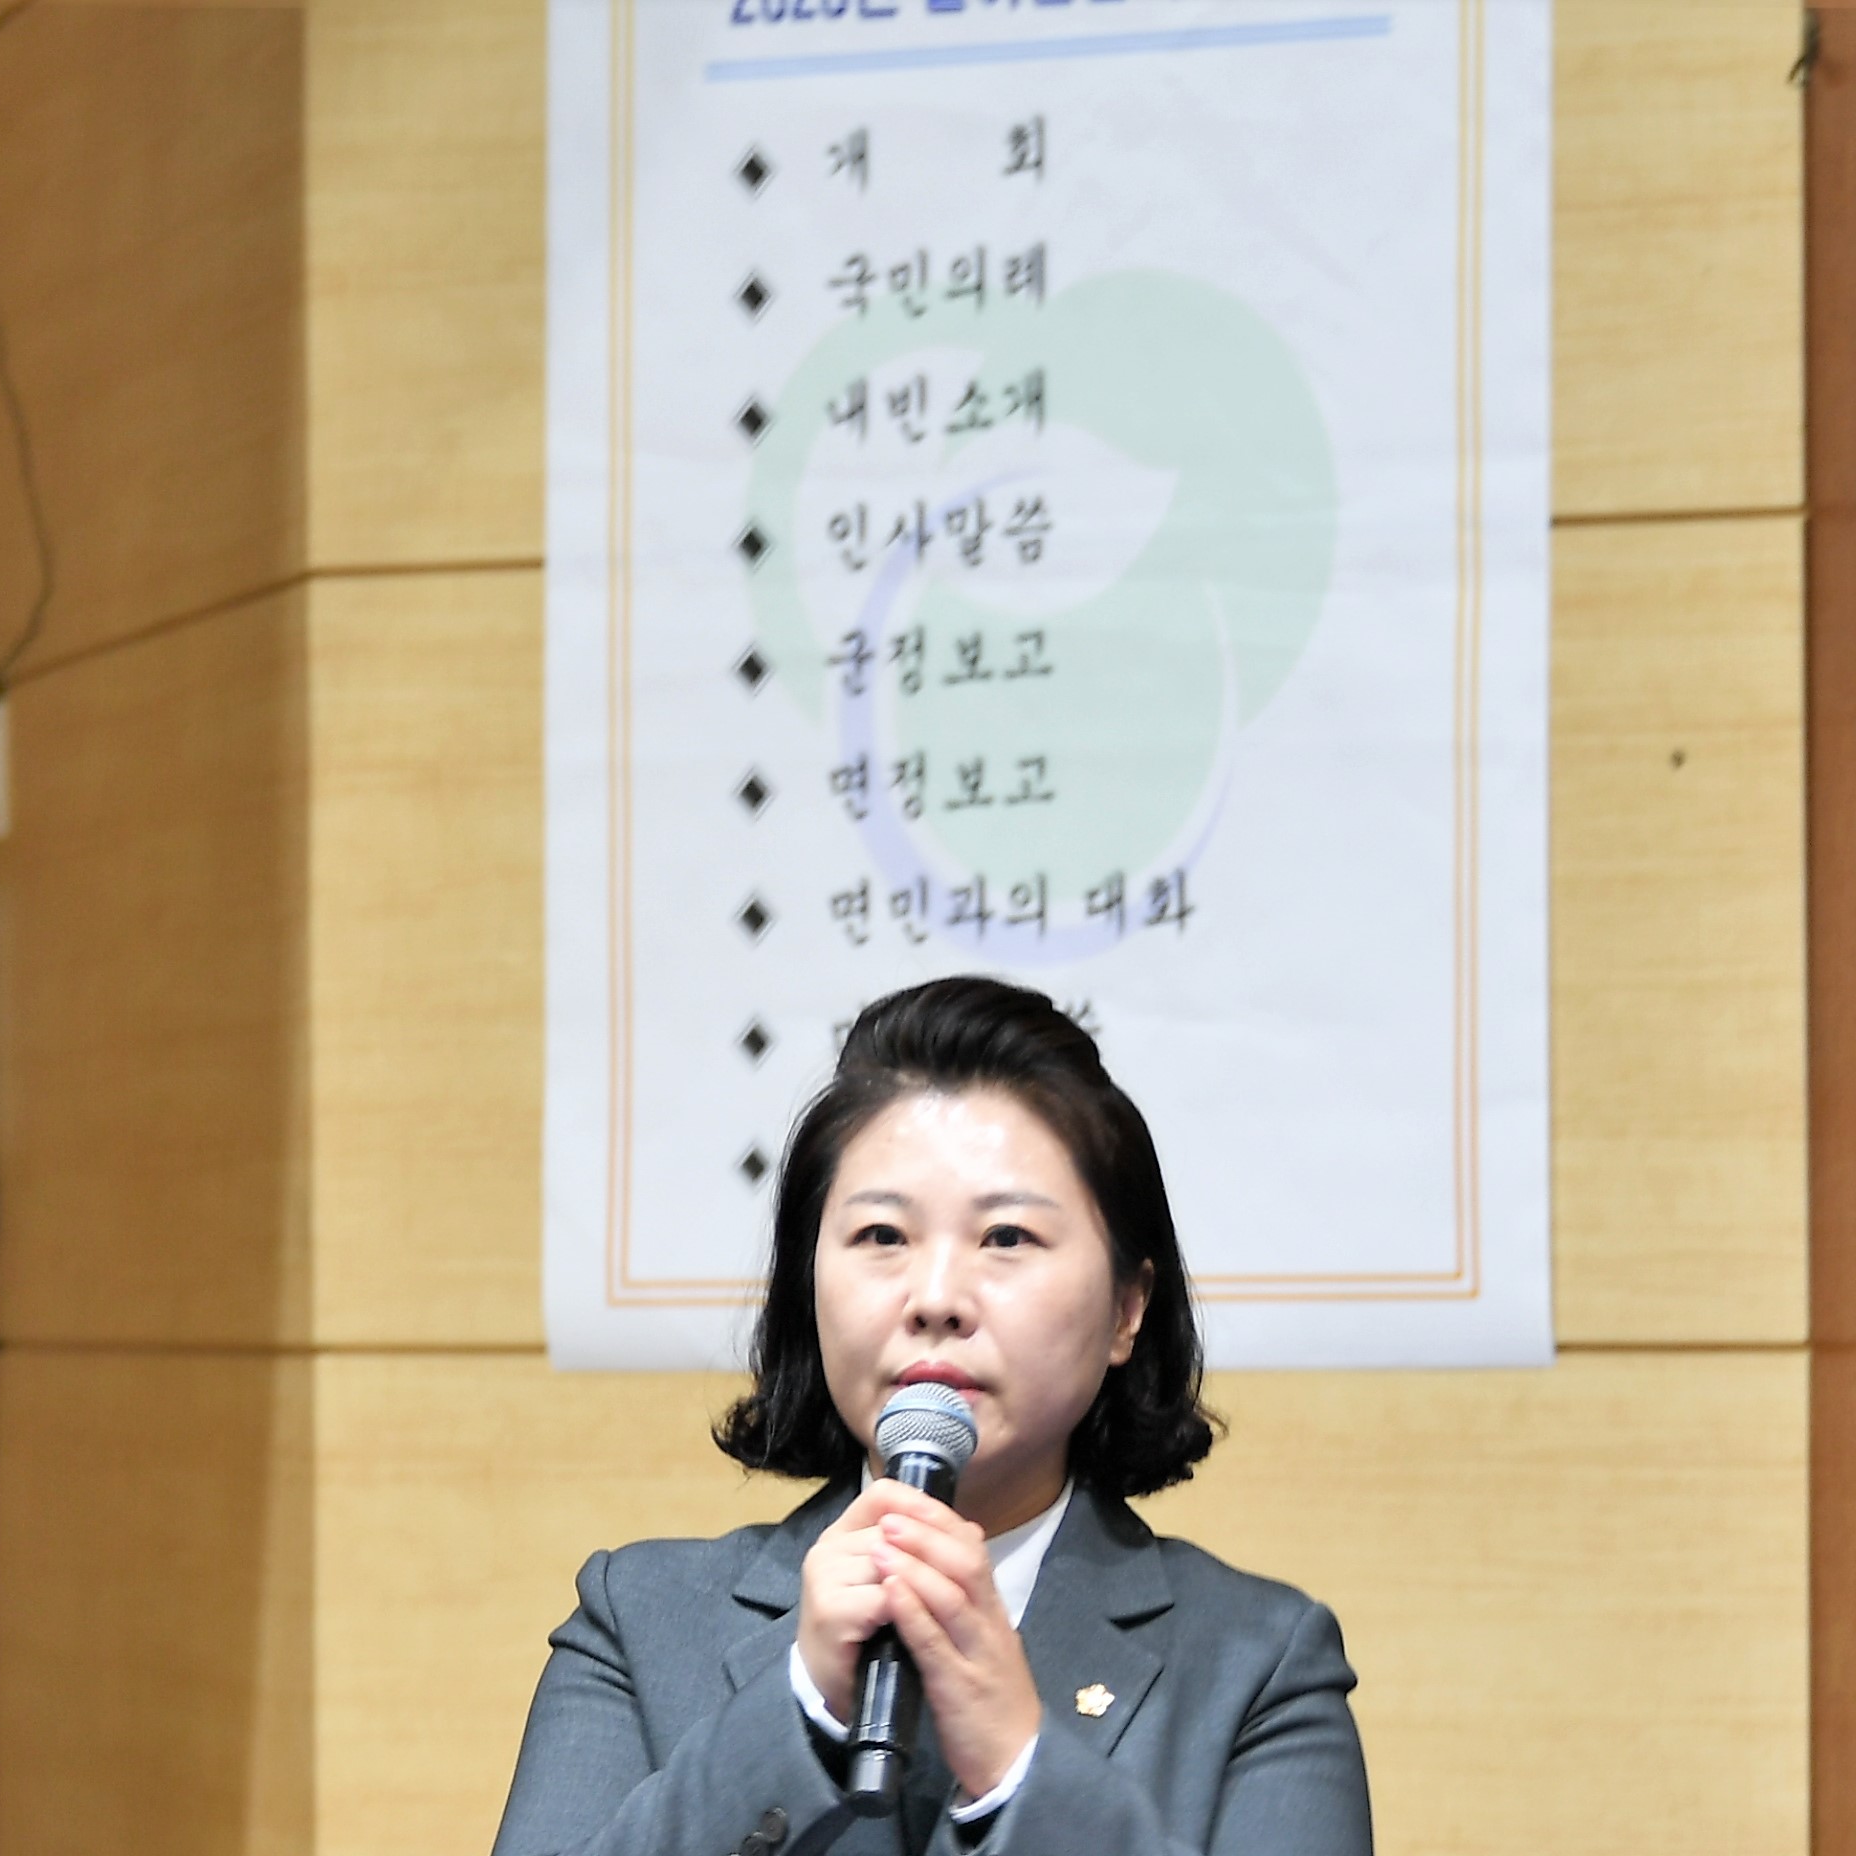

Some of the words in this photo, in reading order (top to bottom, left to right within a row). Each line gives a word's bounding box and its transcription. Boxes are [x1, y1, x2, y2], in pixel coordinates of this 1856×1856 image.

[825, 242, 1049, 320] 국민의례
[825, 367, 1049, 442] 내빈소개
[826, 496, 1054, 572] 인사말씀
[824, 625, 1055, 697] 군정보고
[828, 749, 1056, 821] 면정보고
[829, 872, 1049, 948] 면민과의
[1083, 867, 1197, 940] 대화
